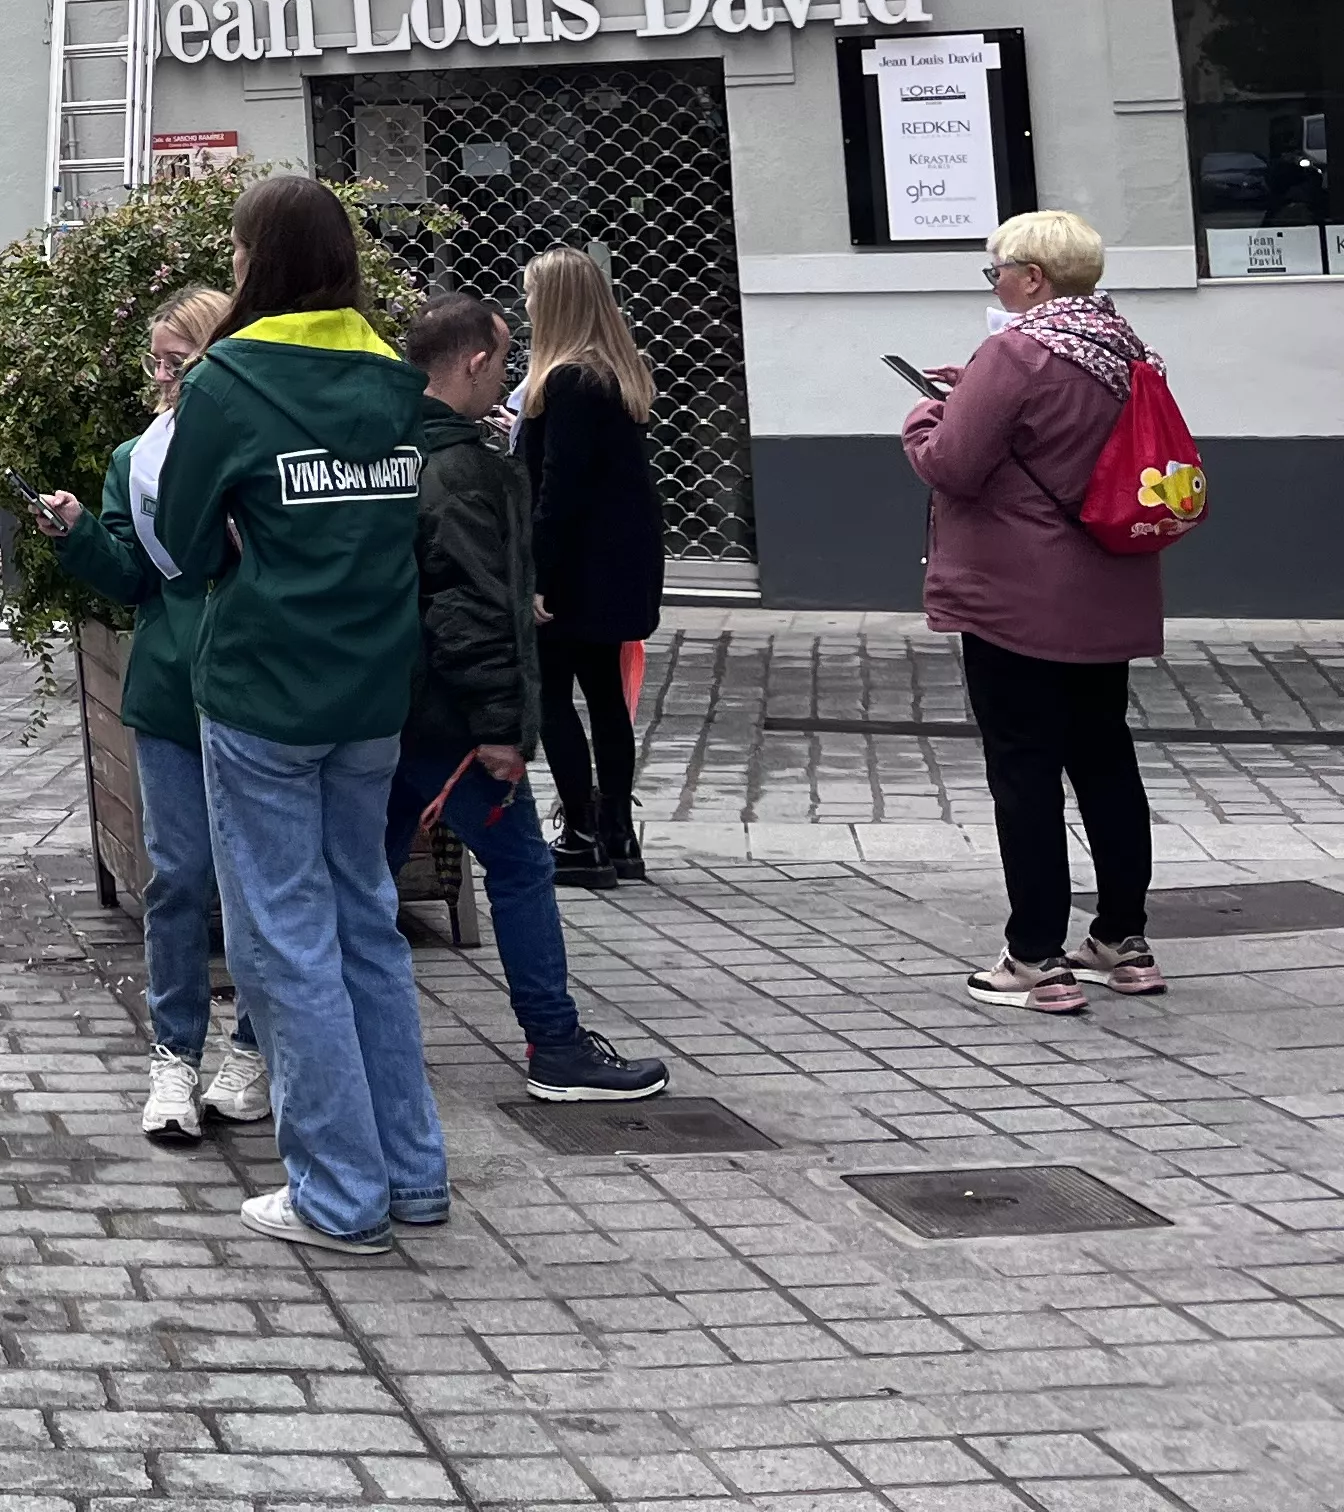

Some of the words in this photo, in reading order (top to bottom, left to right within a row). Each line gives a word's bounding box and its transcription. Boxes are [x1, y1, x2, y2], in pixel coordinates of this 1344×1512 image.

[879, 55, 908, 67] Jean
[911, 53, 944, 66] Louis
[948, 52, 983, 64] David
[901, 120, 971, 134] REDKEN
[908, 154, 968, 165] KÉRASTASE
[906, 179, 946, 203] ghd
[914, 214, 971, 224] OLAPLEX
[1248, 235, 1275, 246] Jean
[1248, 246, 1282, 256] Louis
[1248, 255, 1283, 267] David
[288, 460, 333, 493] VIVA
[332, 459, 367, 490] SAN
[368, 457, 419, 488] MARTIN
